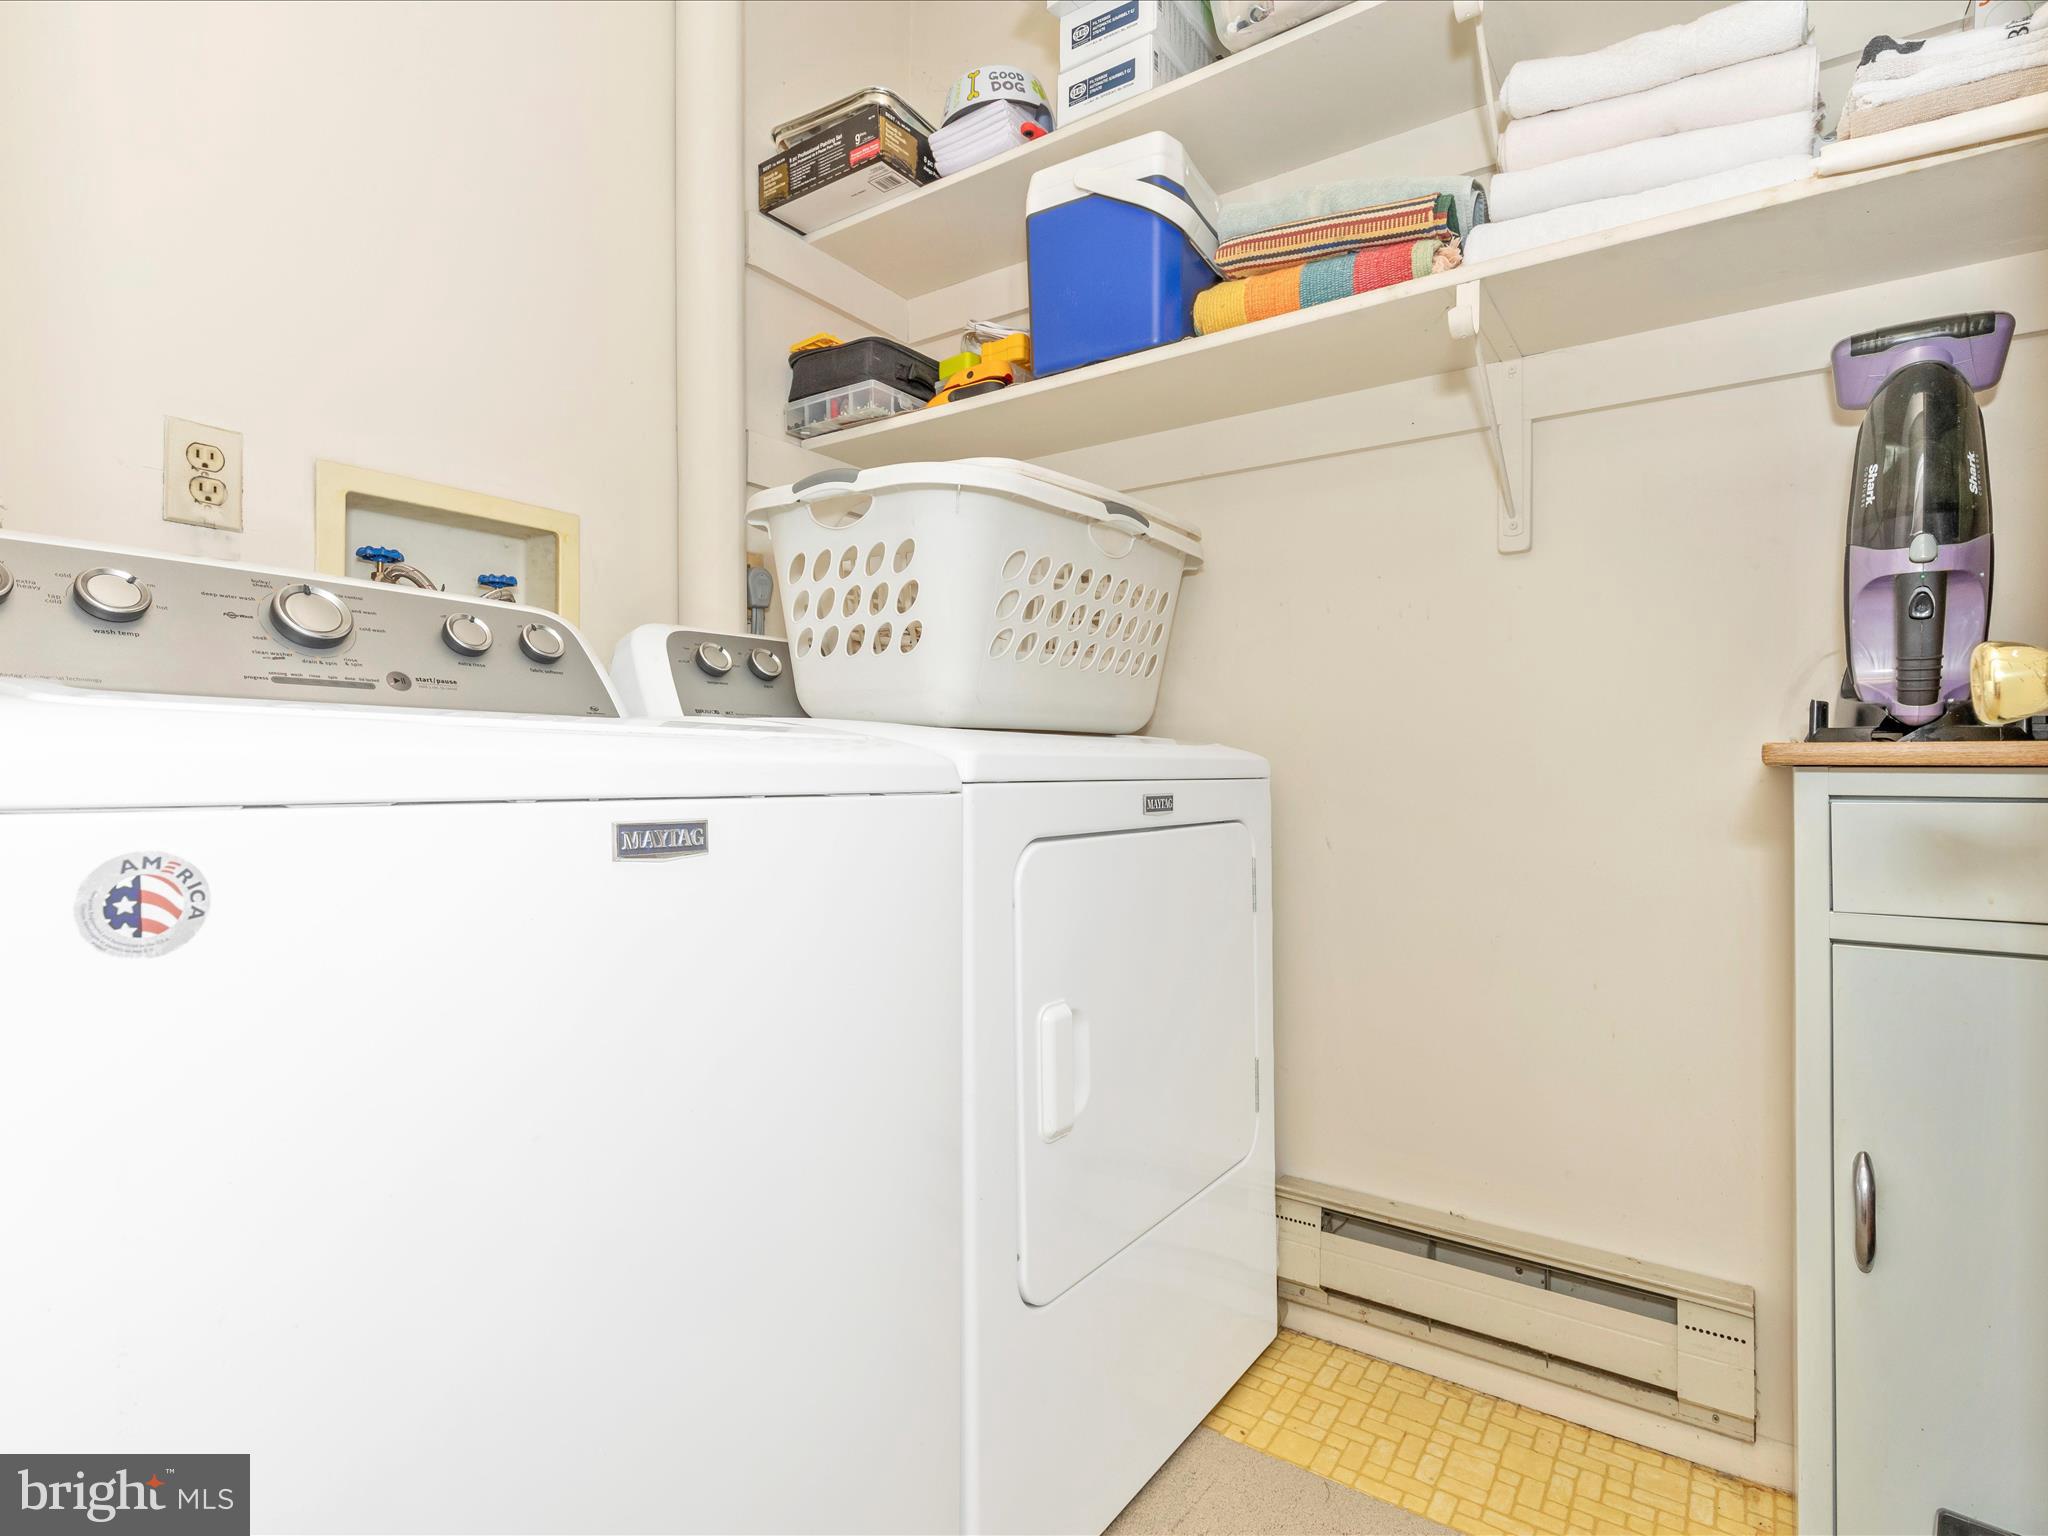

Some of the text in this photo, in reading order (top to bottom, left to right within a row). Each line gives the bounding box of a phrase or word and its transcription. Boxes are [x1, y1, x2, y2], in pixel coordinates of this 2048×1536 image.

[989, 71, 1024, 81] GOOD
[991, 81, 1026, 93] DOG
[854, 133, 861, 145] 9
[1967, 450, 1979, 495] Shark
[1865, 463, 1879, 508] Shark
[54, 571, 72, 579] cold
[16, 583, 41, 591] heavy
[92, 628, 140, 638] wash temp
[1146, 797, 1173, 810] MAYTAG
[620, 827, 705, 850] MAYTAG
[119, 855, 206, 921] AMERICA
